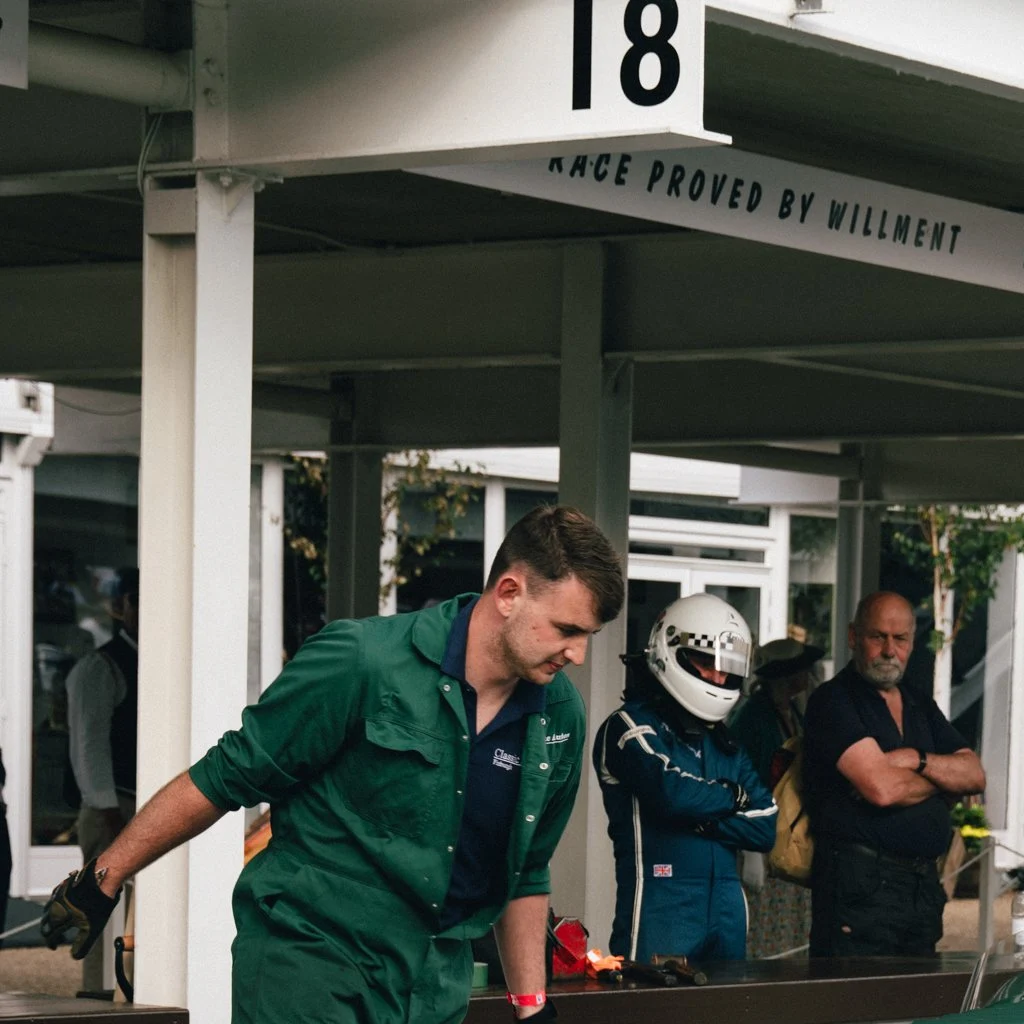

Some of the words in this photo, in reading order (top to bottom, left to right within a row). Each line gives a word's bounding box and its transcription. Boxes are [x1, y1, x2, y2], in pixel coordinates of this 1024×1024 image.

[571, 0, 681, 111] 18
[646, 159, 763, 213] PROVED
[777, 188, 815, 224] BY
[827, 199, 962, 255] WILLMENT
